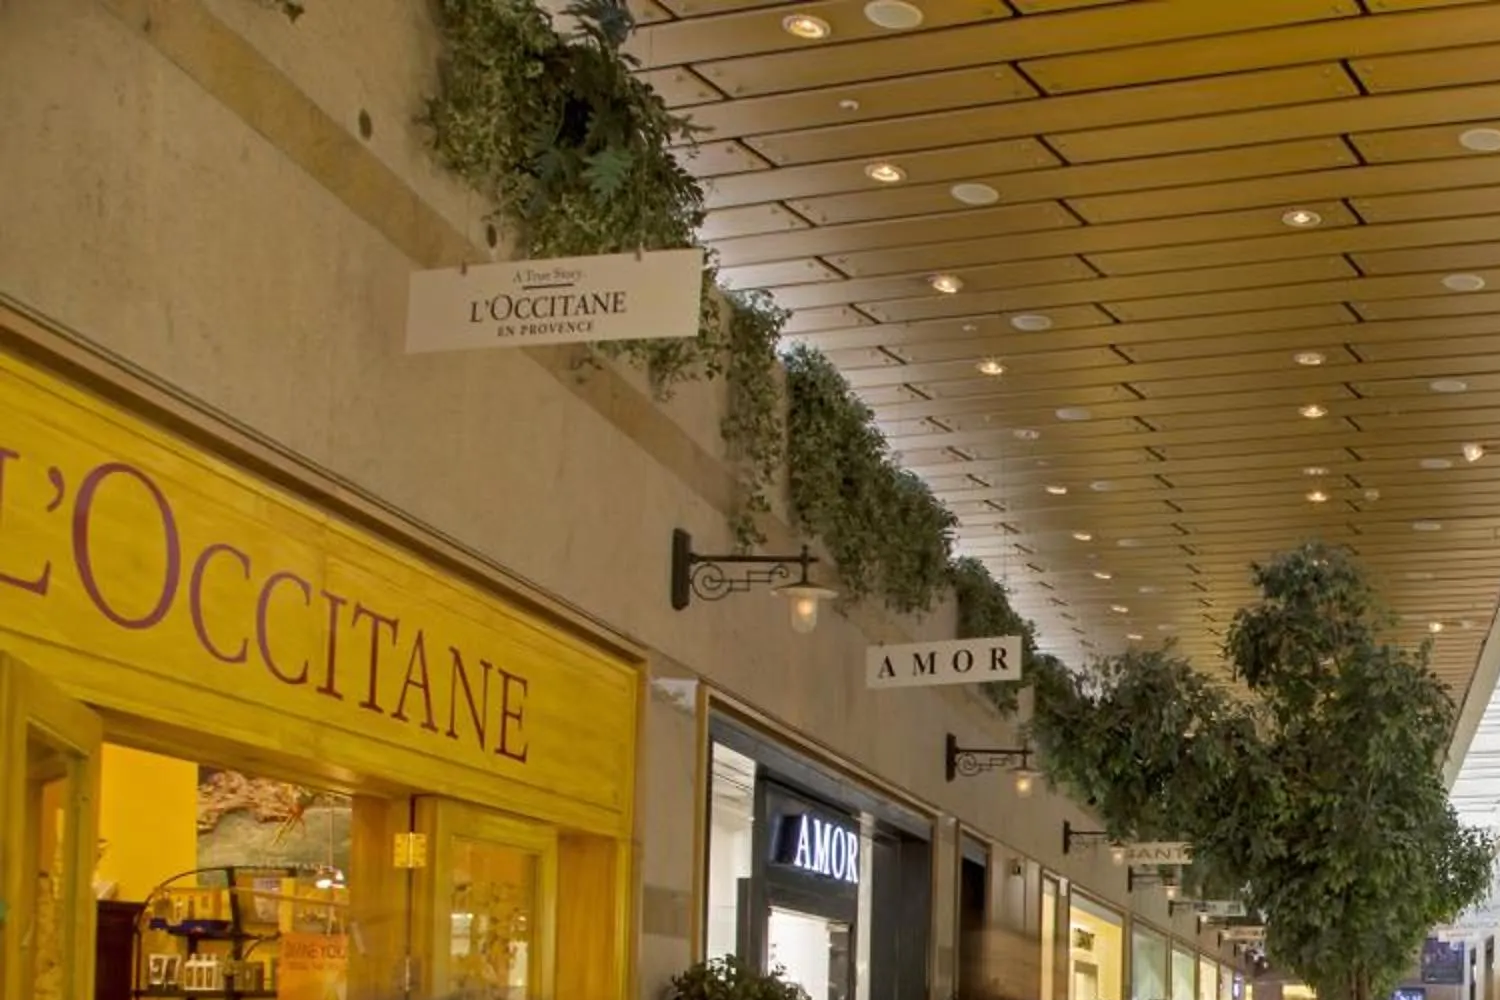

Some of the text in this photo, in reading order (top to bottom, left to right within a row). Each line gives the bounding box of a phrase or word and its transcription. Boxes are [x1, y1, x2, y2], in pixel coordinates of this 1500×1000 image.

[469, 291, 627, 322] L'OCCITANE
[497, 321, 593, 337] EN PROVENCE
[877, 647, 1008, 679] AMOR
[793, 812, 859, 884] AMOR
